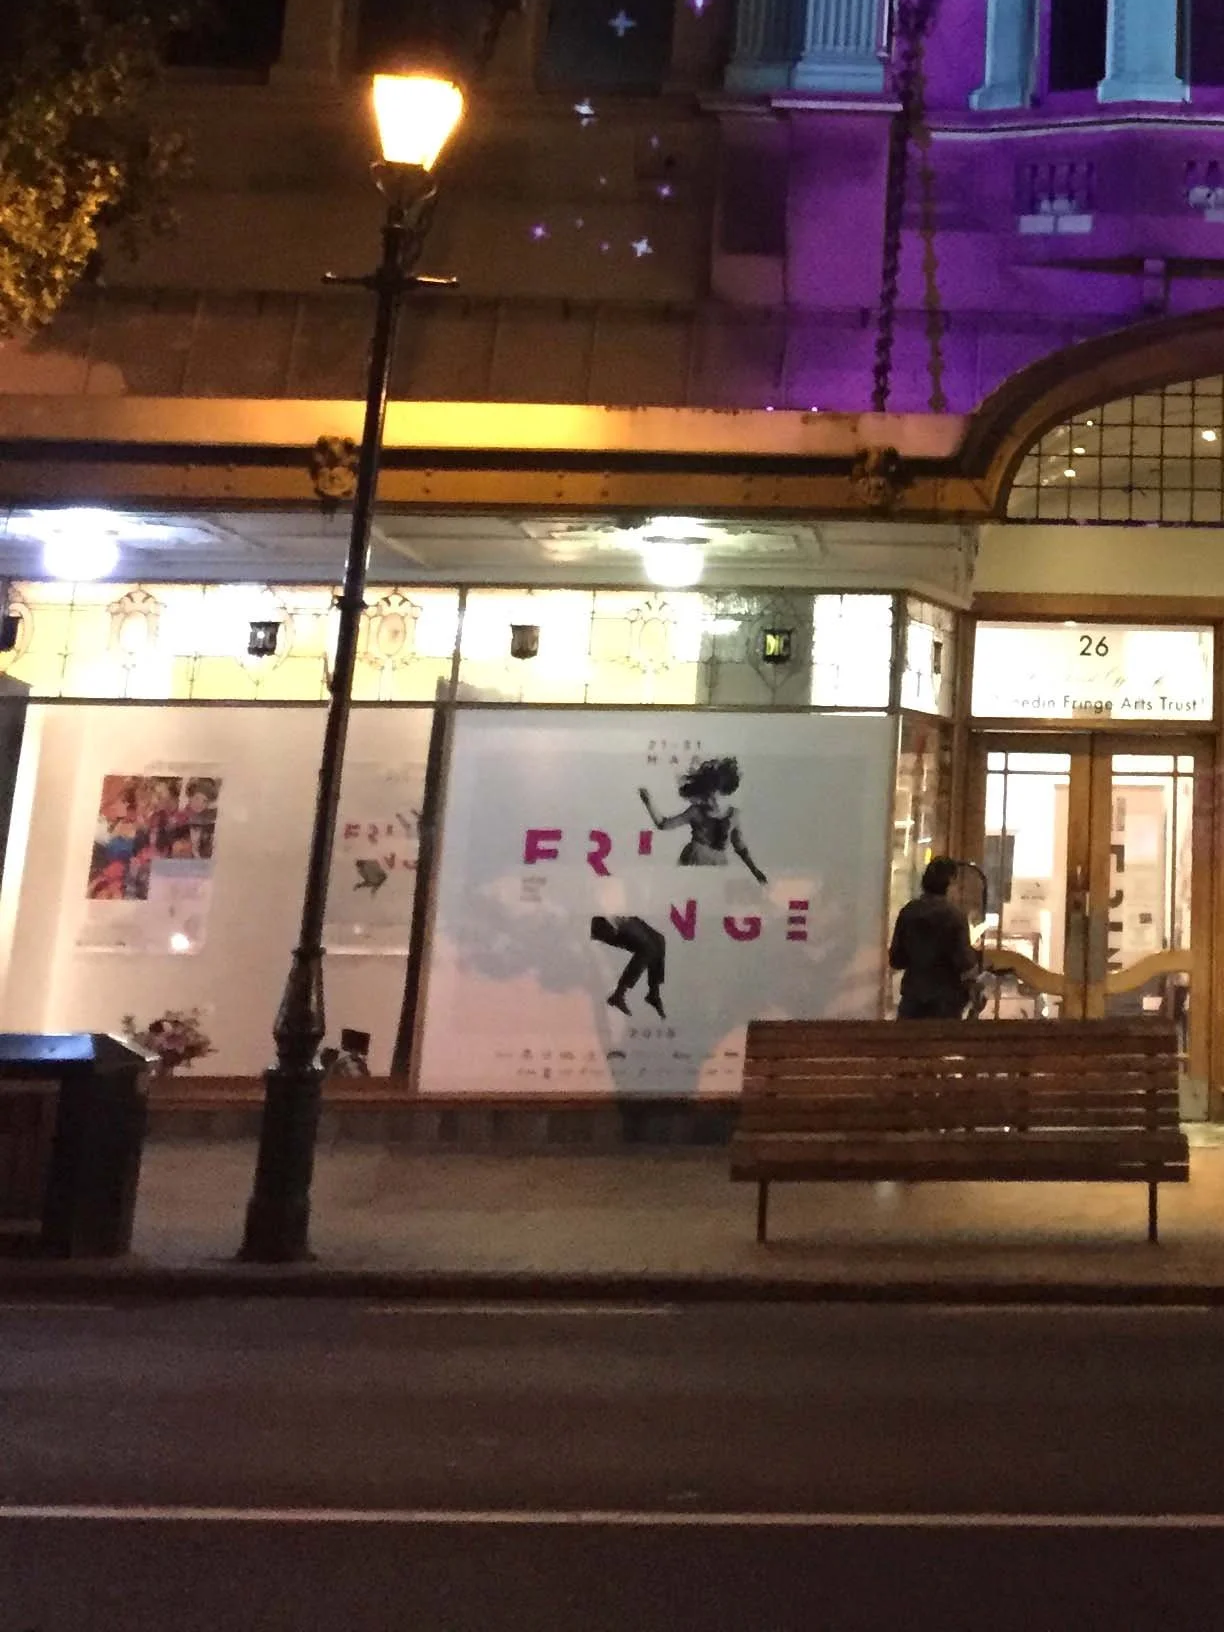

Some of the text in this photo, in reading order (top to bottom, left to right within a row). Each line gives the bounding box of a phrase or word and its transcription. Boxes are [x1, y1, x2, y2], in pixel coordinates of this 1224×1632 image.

[1079, 635, 1109, 657] 26
[1063, 695, 1113, 716] Fringe
[1121, 697, 1153, 711] Arts
[1160, 696, 1198, 712] Trust
